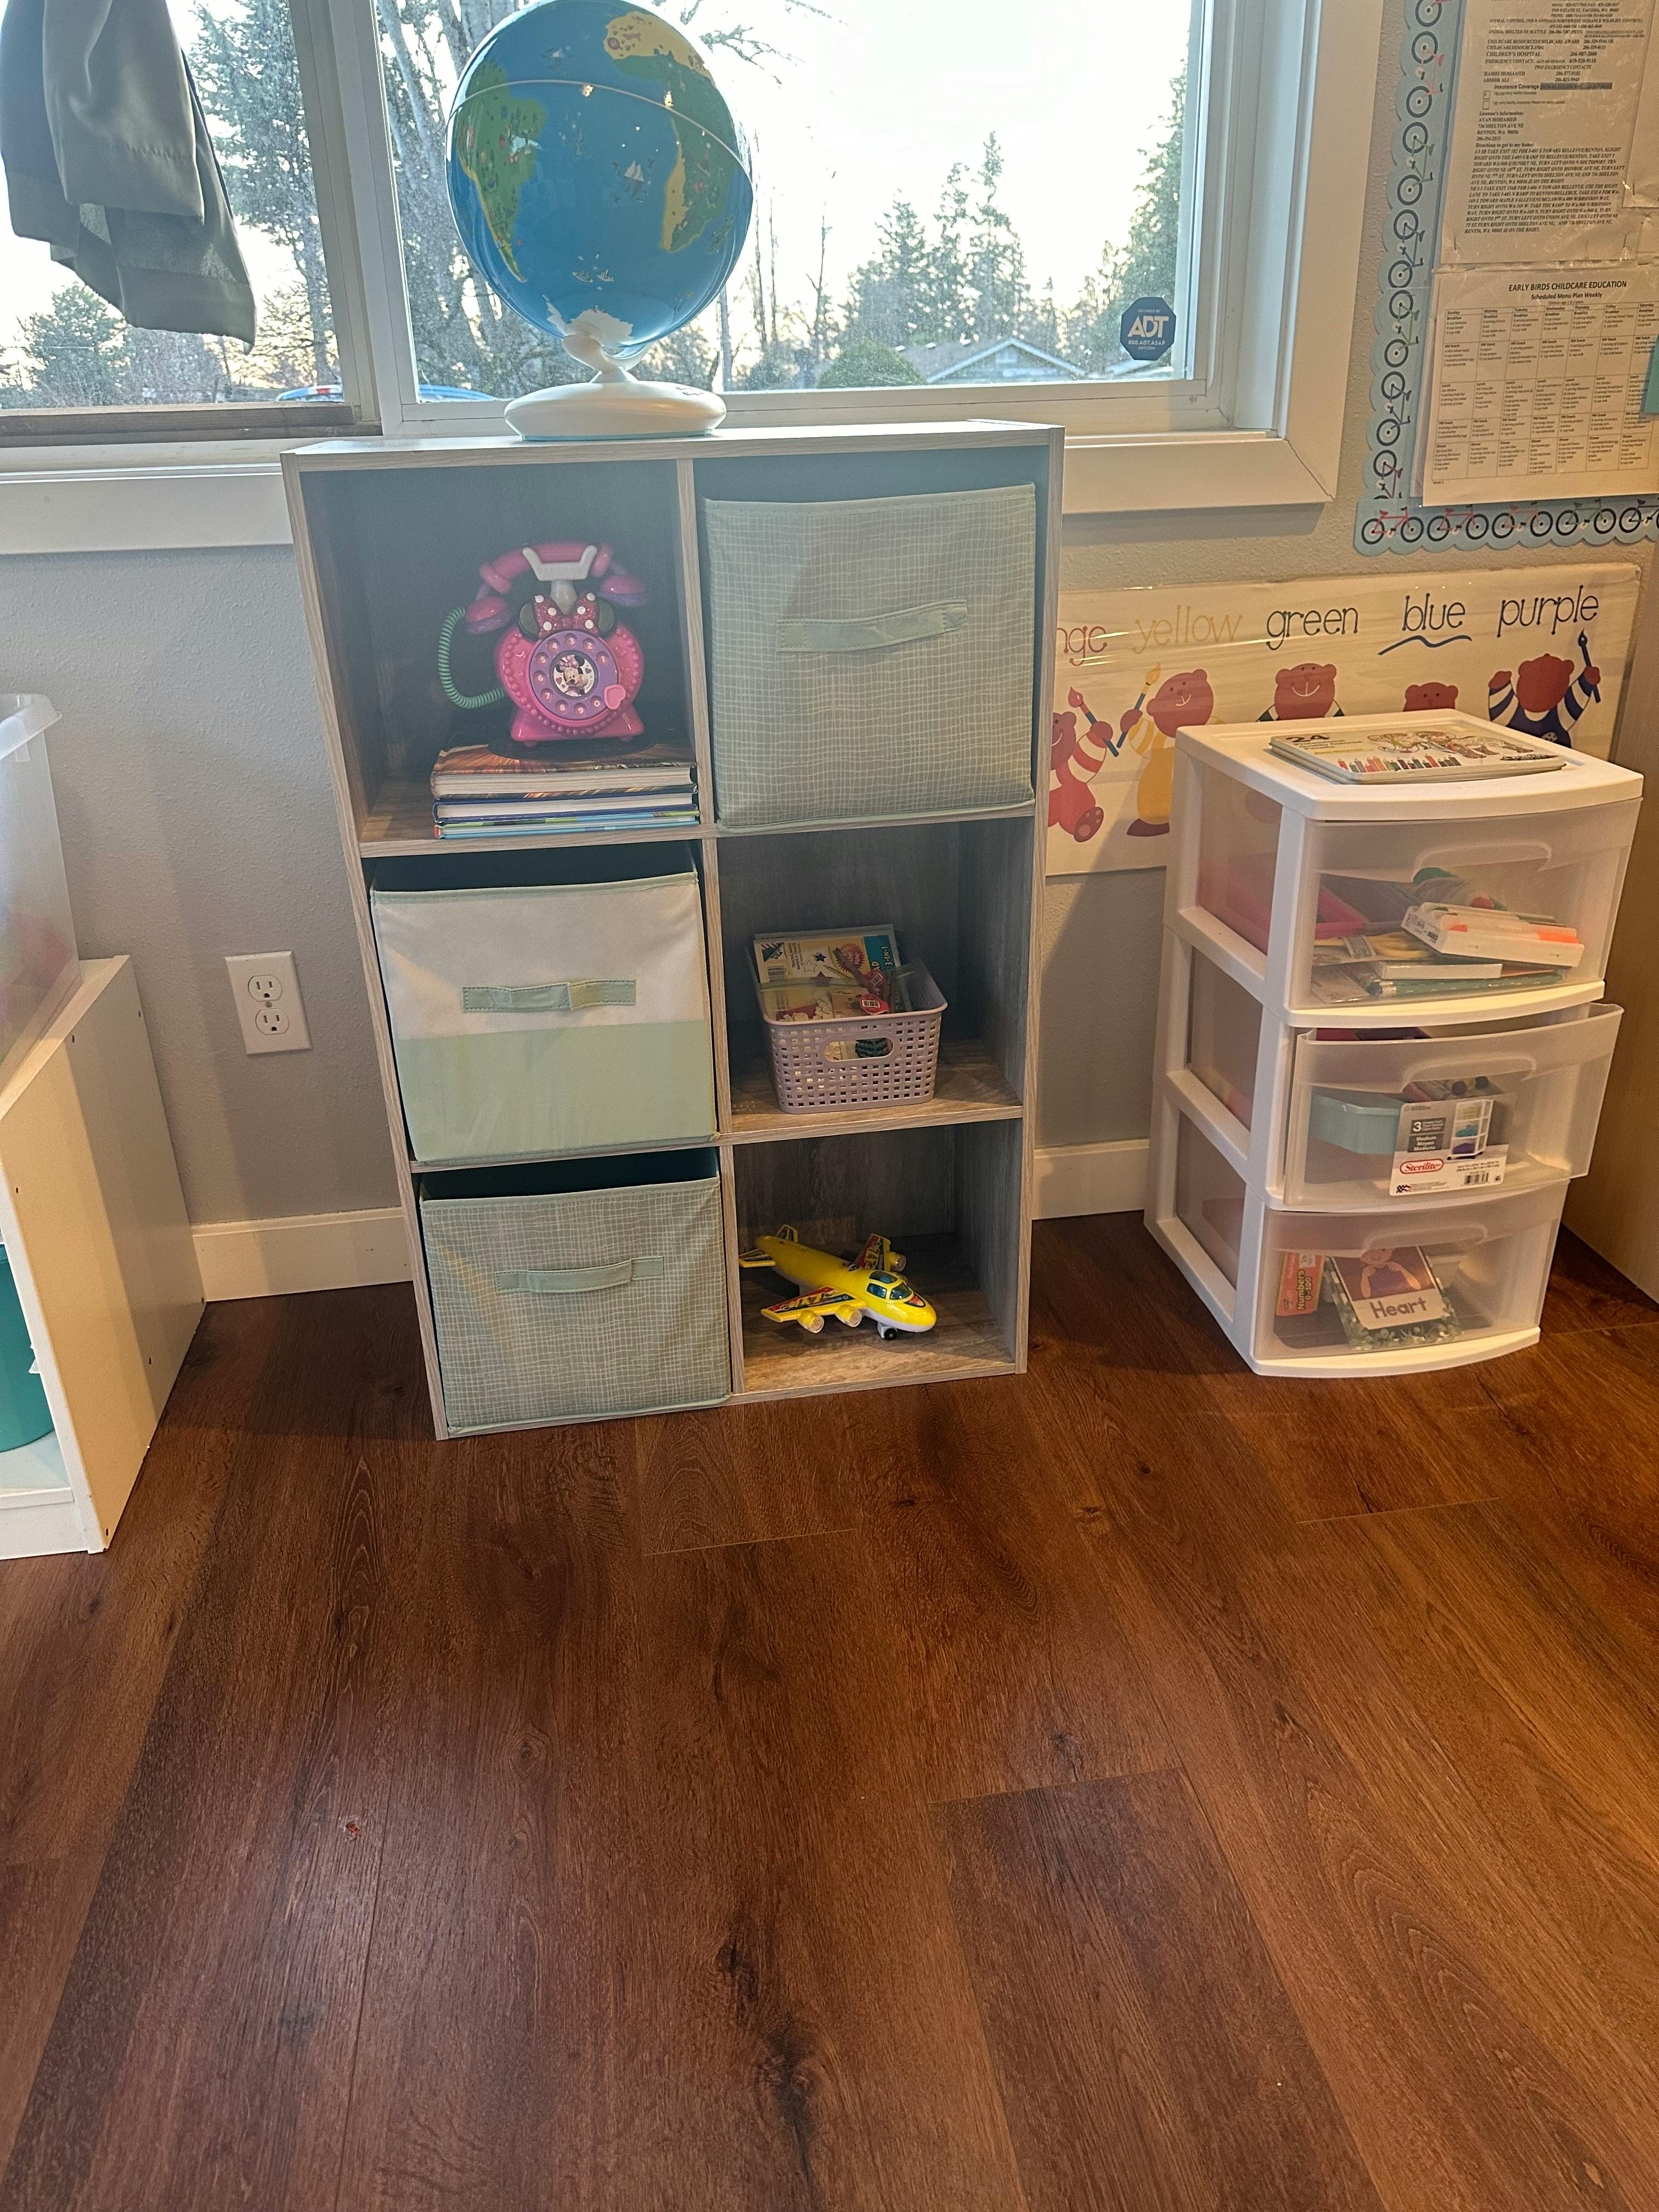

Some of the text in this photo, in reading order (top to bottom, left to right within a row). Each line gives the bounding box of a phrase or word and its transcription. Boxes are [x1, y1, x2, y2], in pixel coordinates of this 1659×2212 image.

[1509, 284, 1530, 292] EARLY
[1551, 281, 1588, 290] CHILDCARE
[1588, 280, 1627, 289] EDUCATION
[1127, 315, 1170, 338] ADT
[1057, 585, 1599, 666] nge yellow green blue purple
[1413, 1121, 1422, 1132] 3
[1404, 1161, 1437, 1172] Sterilite
[1296, 1269, 1305, 1310] Numbers
[1369, 1298, 1426, 1318] Heart
